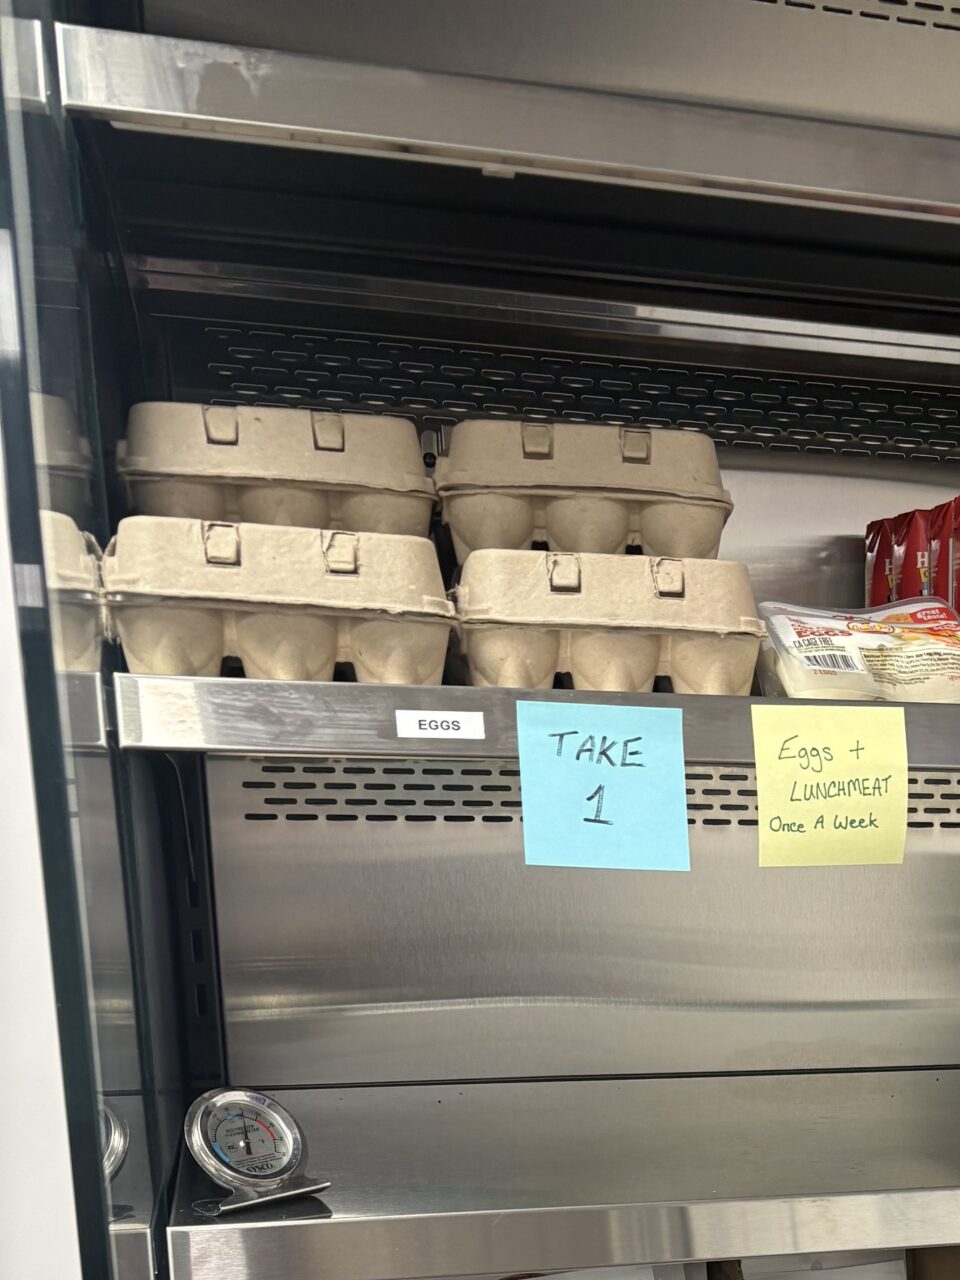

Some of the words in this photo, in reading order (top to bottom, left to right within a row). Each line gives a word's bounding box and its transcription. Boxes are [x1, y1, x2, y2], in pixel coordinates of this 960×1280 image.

[802, 639, 819, 647] CAGE
[819, 637, 835, 646] FREE
[418, 719, 461, 732] EGGS
[548, 731, 646, 767] TAKE
[778, 735, 833, 773] Eggs
[849, 740, 864, 759] +
[790, 775, 892, 802] LUNCHMEAT
[583, 784, 614, 825] 1
[769, 815, 806, 833] Once
[814, 815, 824, 830] A
[833, 812, 879, 830] Week
